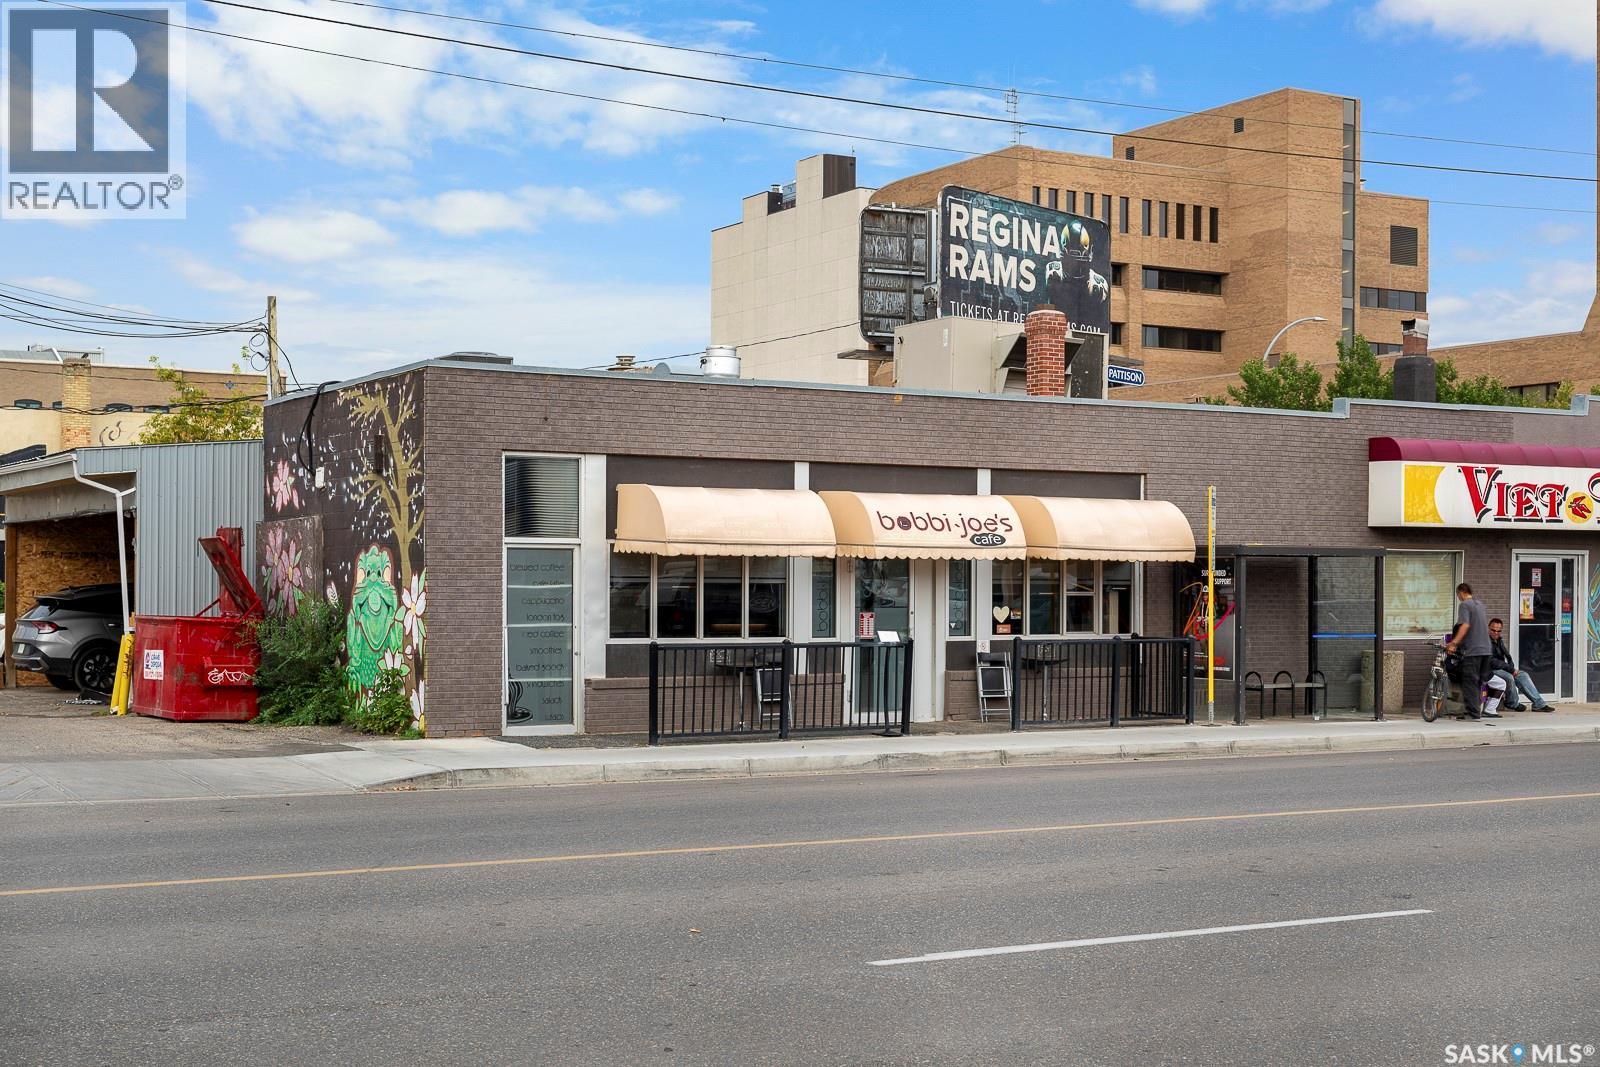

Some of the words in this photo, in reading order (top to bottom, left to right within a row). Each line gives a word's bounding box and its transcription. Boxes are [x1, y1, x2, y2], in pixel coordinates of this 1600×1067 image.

[950, 202, 1062, 259] REGINA
[949, 243, 1037, 293] RAMS
[949, 300, 994, 321] TICKETS
[997, 310, 1010, 322] AT
[1107, 367, 1143, 383] PATTISON
[973, 533, 1002, 546] cafe
[540, 564, 566, 572] coffee
[540, 630, 565, 638] coffee
